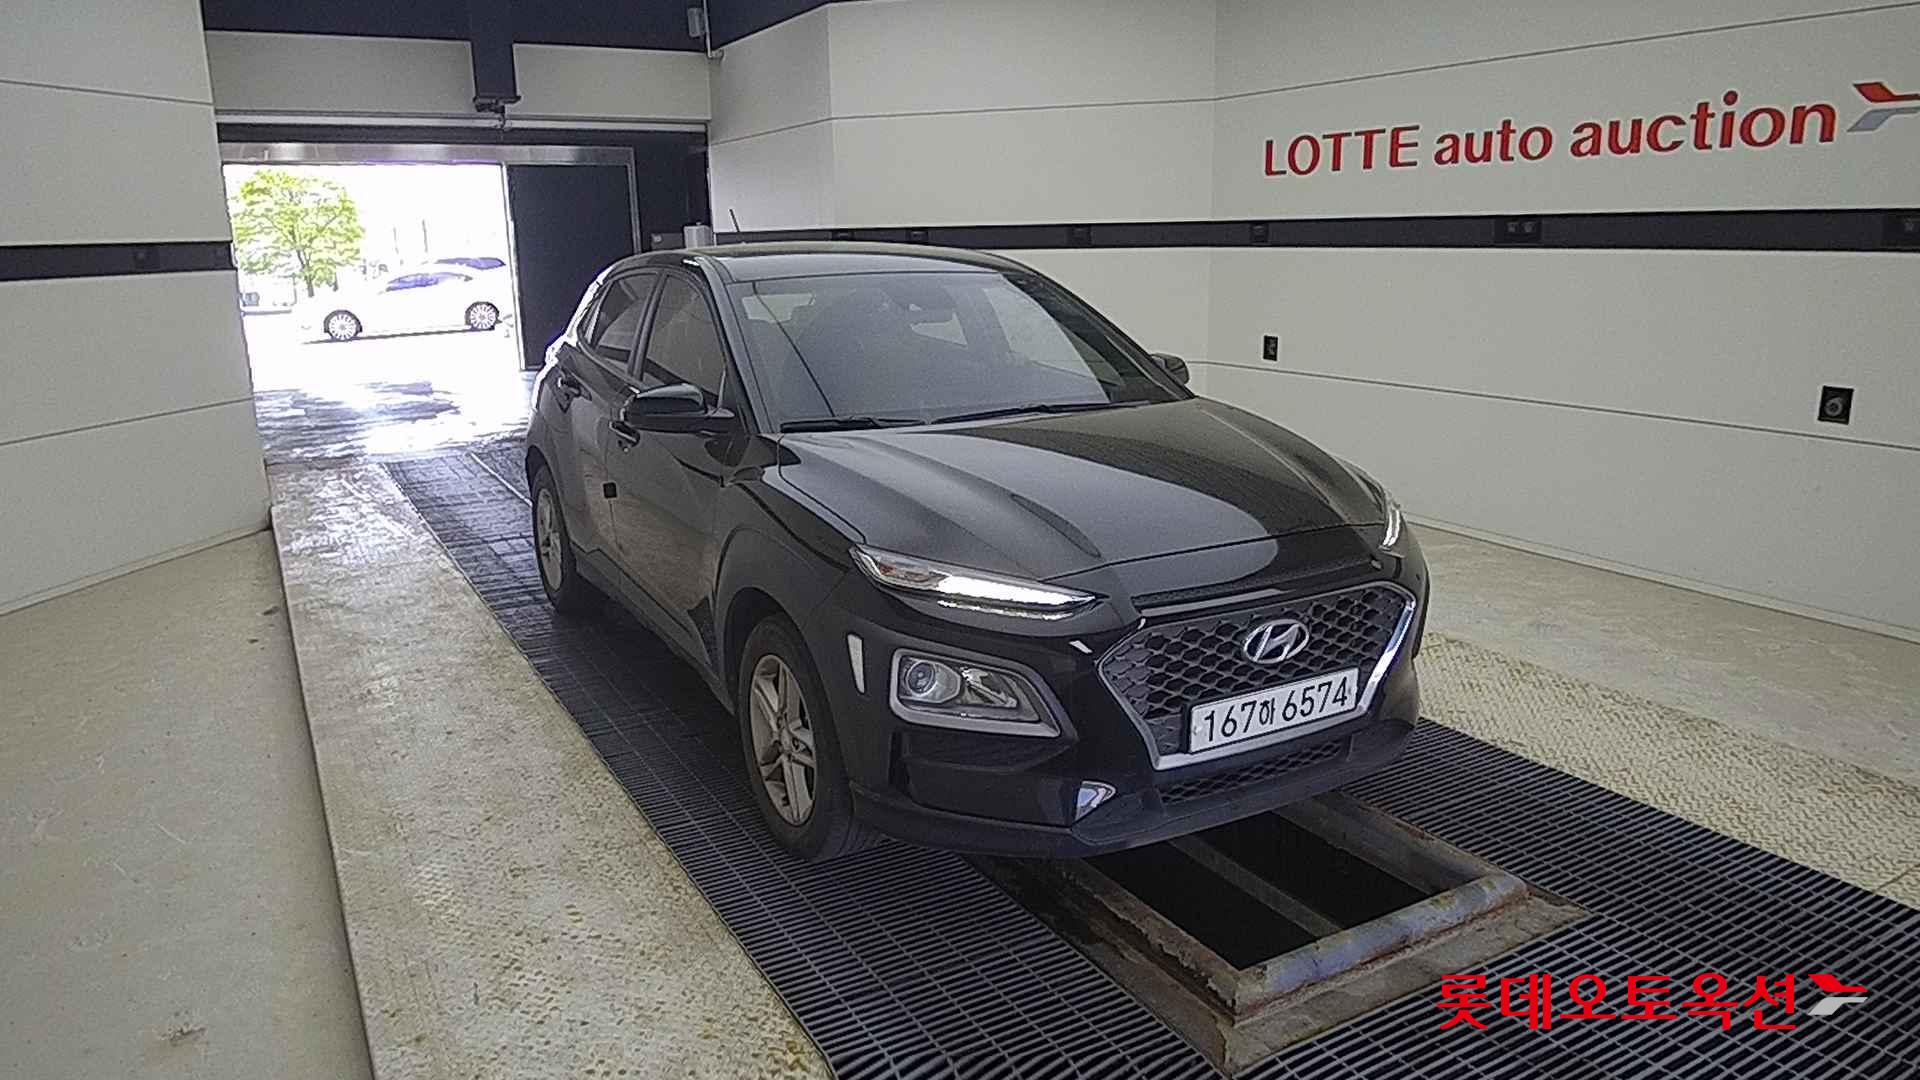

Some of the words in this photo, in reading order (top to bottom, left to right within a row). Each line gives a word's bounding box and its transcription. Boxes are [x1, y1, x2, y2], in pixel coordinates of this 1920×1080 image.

[1264, 124, 1420, 176] LOTTE
[1434, 120, 1553, 165] auto
[1570, 91, 1836, 158] auction
[1204, 697, 1276, 742] 167하
[1281, 676, 1348, 722] 6574
